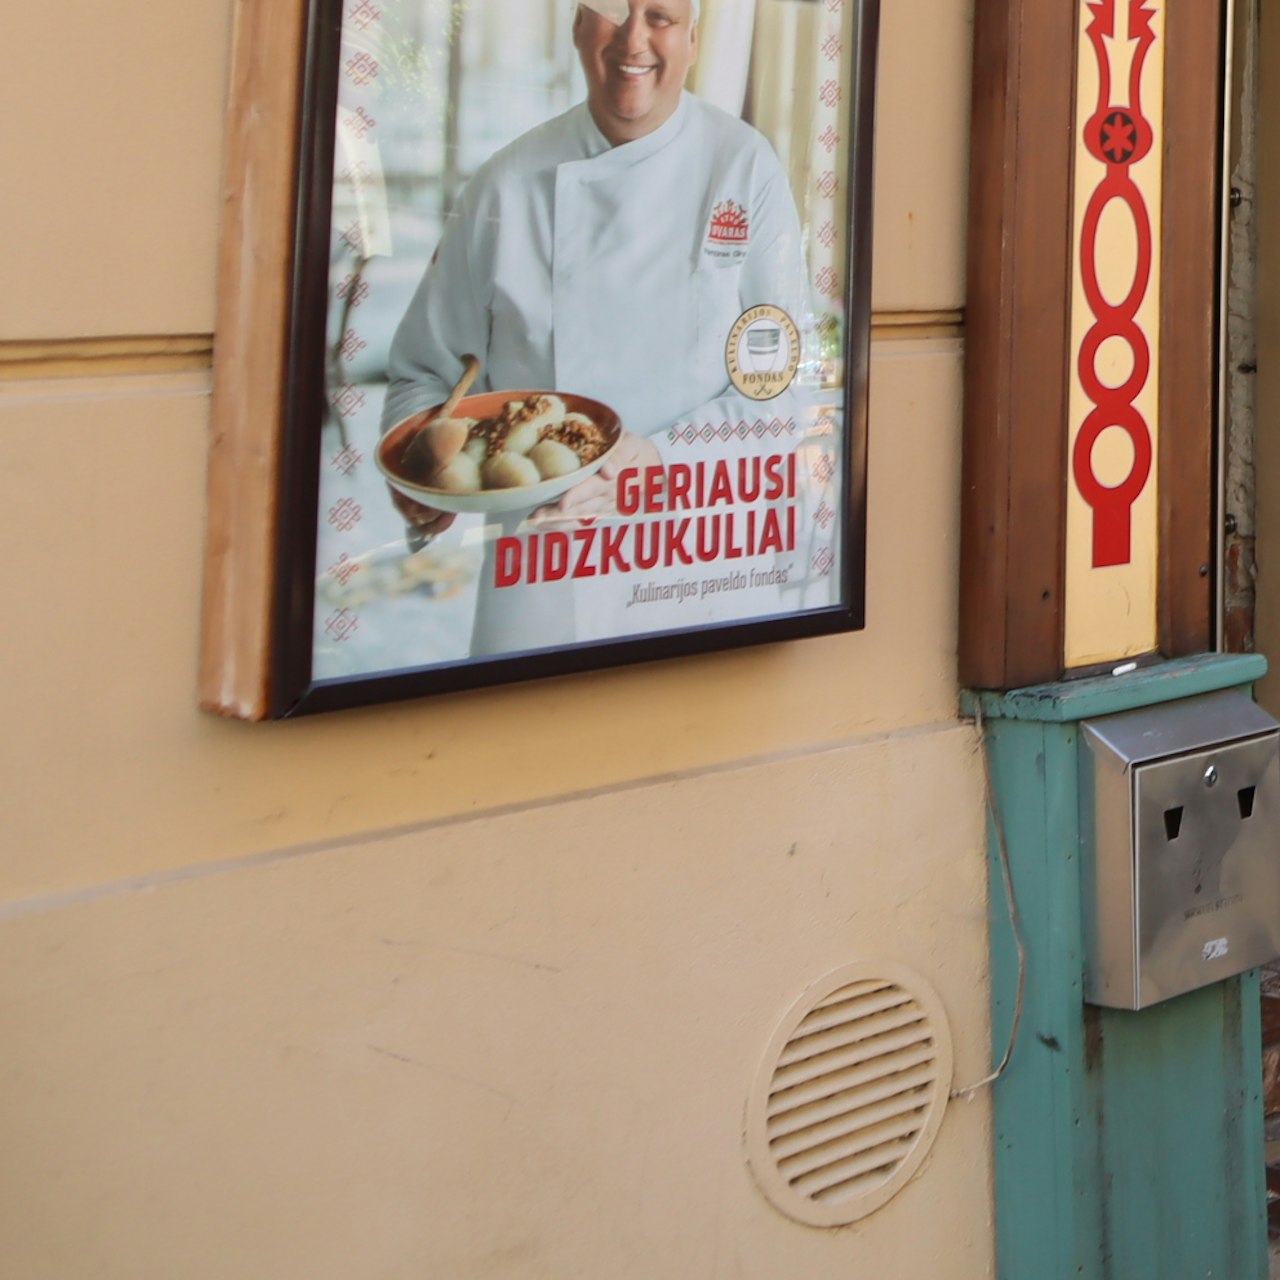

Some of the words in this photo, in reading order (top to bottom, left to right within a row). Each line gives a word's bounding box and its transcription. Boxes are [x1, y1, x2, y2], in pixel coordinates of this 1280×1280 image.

[743, 372, 784, 384] FONDAS
[616, 452, 796, 517] GERIAUSI
[494, 505, 796, 588] DIDŽKUKULIAI
[701, 573, 747, 596] paveldo
